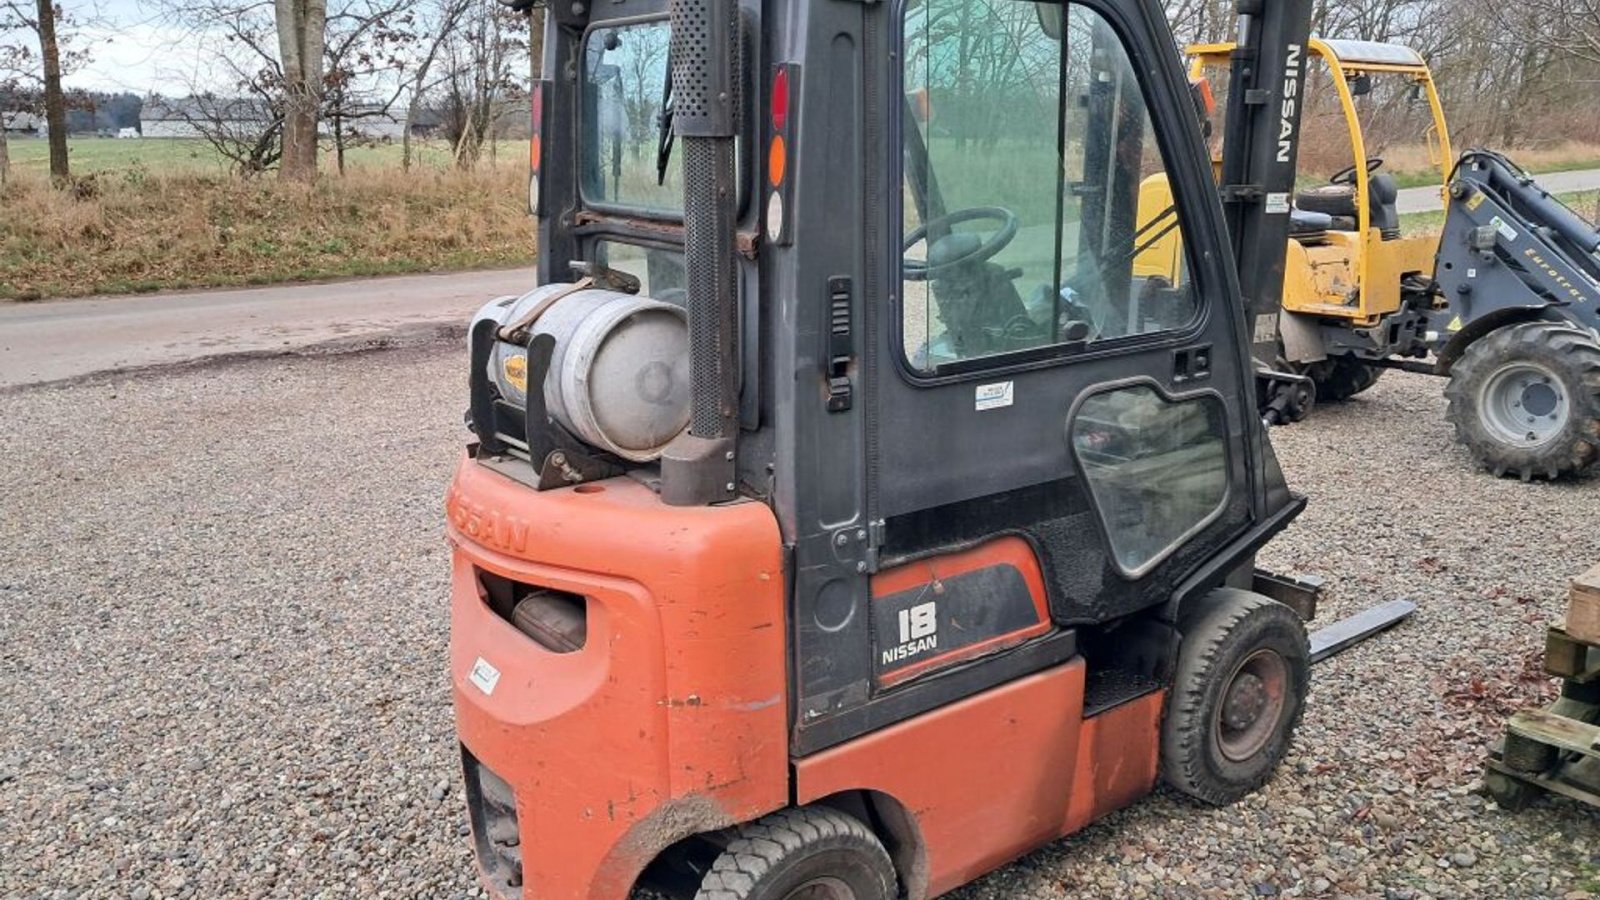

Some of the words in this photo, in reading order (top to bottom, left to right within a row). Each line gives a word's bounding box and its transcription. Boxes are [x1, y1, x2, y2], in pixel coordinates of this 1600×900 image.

[1276, 44, 1301, 162] NISSAN
[898, 601, 937, 643] 18
[882, 634, 937, 665] NISSAN
